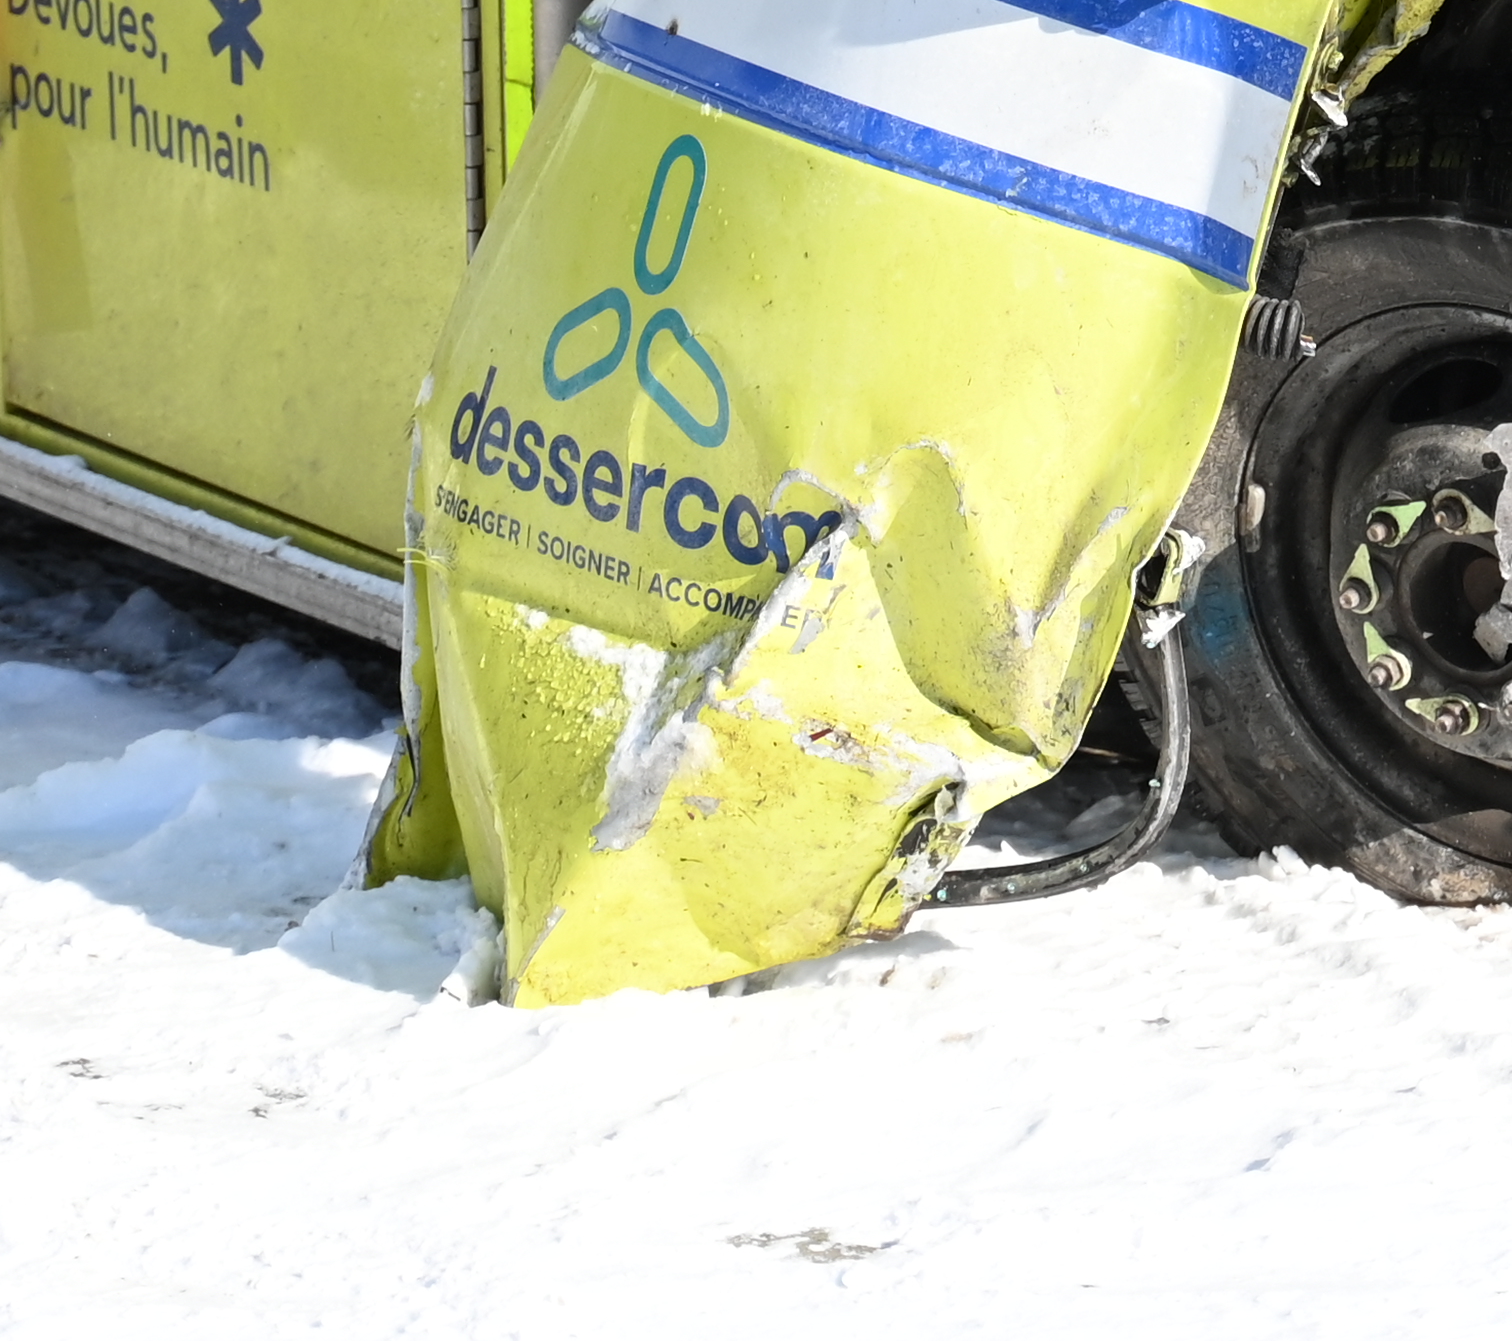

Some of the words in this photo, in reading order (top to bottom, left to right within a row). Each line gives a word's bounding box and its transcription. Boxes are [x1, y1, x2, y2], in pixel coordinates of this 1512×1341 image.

[8, 63, 92, 131] pour
[107, 70, 271, 192] l'humain
[434, 483, 521, 546] S'ENGAGER
[537, 530, 631, 586] SOIGNER
[449, 365, 842, 579] dessercom
